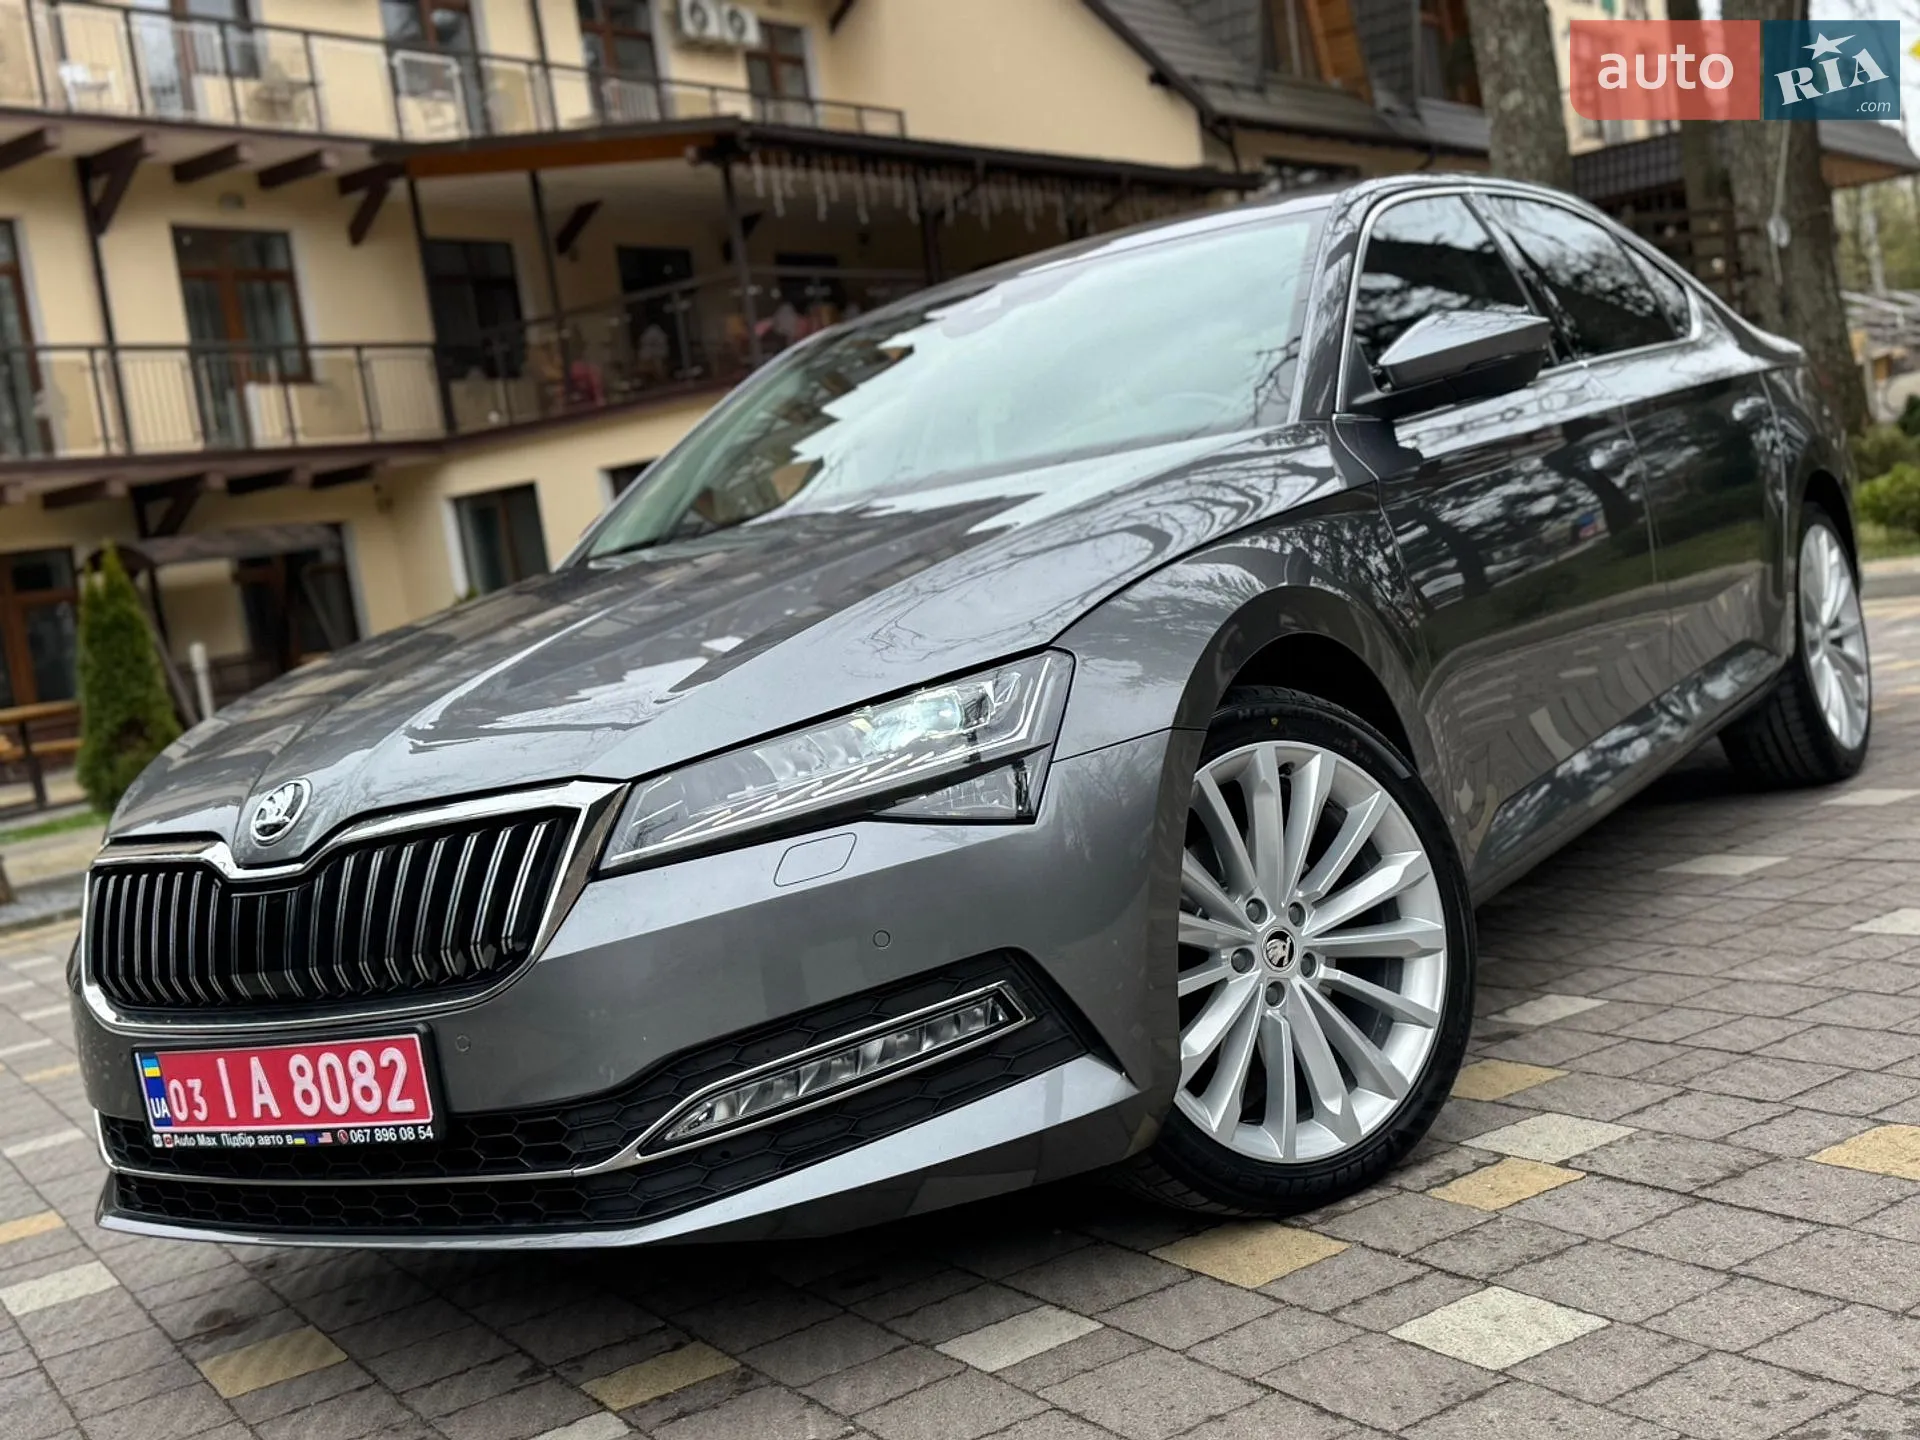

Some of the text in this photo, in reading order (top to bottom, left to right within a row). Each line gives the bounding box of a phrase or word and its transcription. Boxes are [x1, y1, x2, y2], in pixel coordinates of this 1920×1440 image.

[168, 1078, 208, 1122] 03
[289, 1047, 415, 1117] 8082
[150, 1097, 171, 1119] UA
[174, 1134, 196, 1146] Auto
[196, 1134, 217, 1146] Max
[220, 1133, 255, 1147] Підбір
[257, 1134, 283, 1145] авто
[349, 1129, 371, 1143] 067
[374, 1127, 396, 1141] 896
[399, 1126, 415, 1140] 08
[418, 1125, 433, 1139] 54
